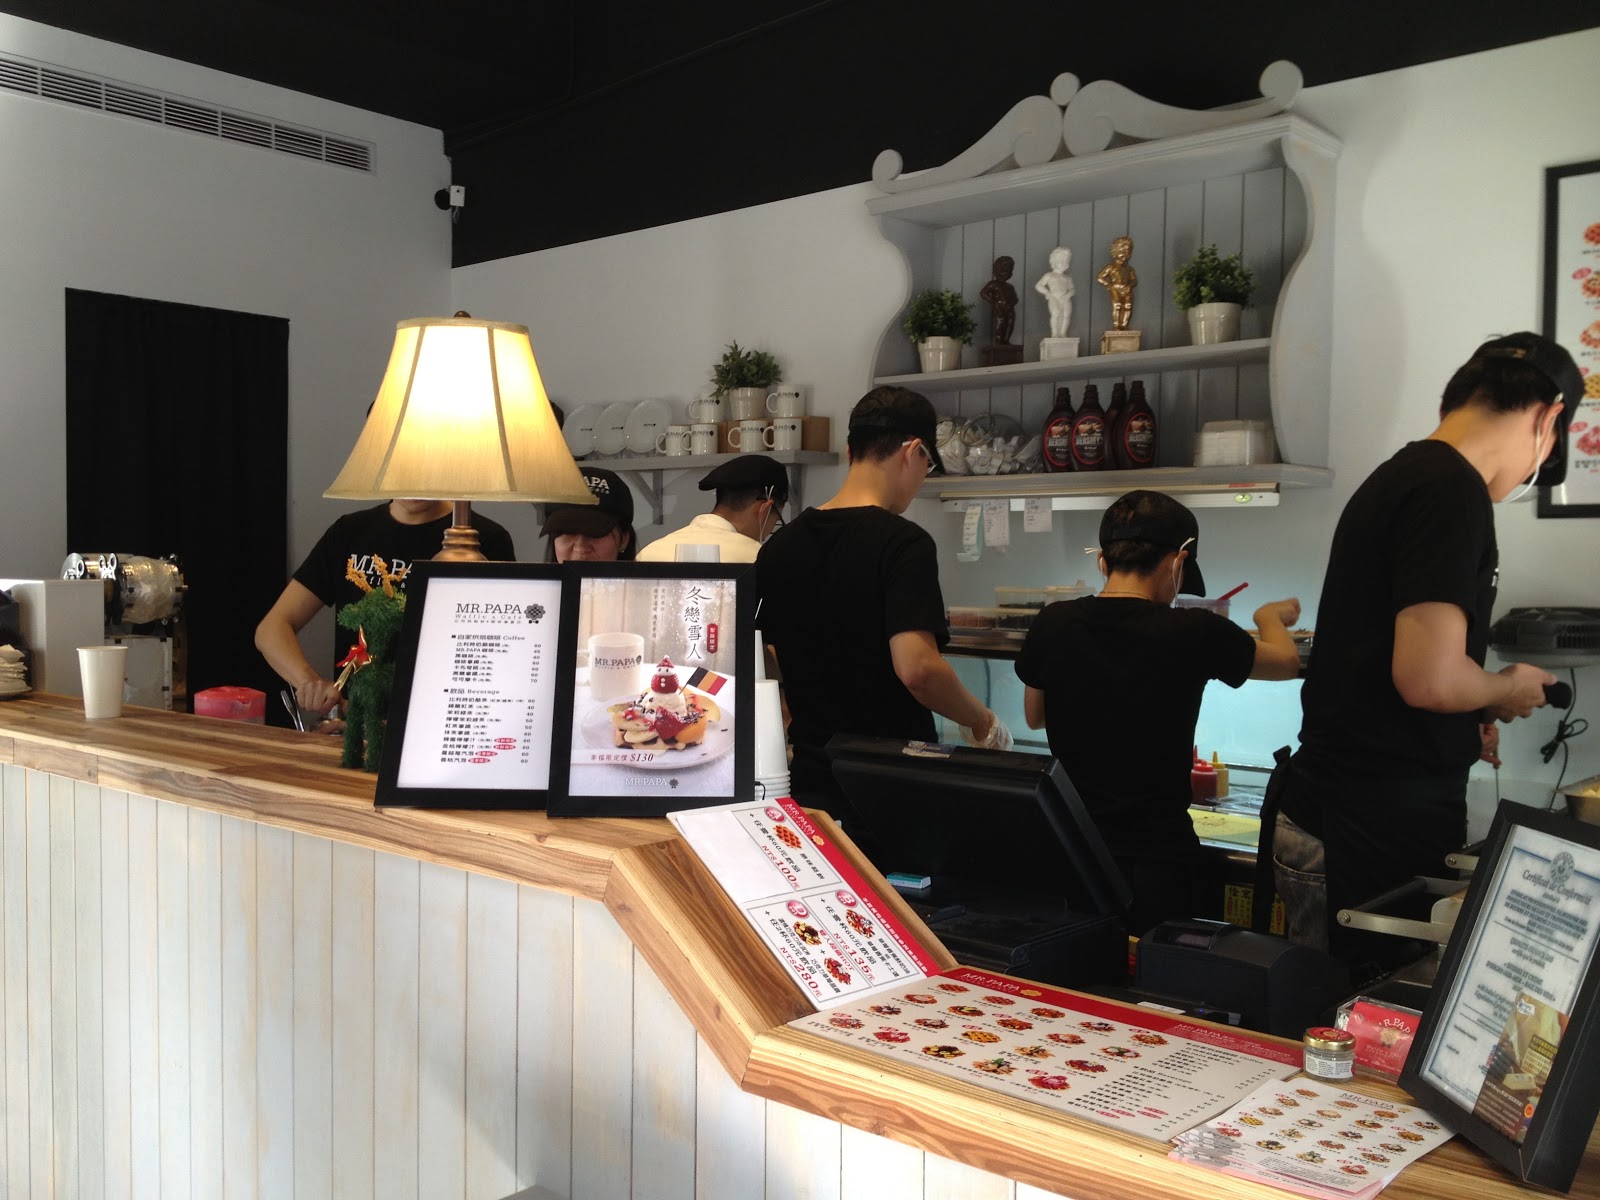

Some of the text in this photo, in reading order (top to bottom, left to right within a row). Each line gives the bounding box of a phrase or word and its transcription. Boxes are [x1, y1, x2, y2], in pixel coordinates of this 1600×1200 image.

[456, 603, 522, 614] MR.PAPA
[684, 586, 712, 660] 冬戀雪人
[595, 657, 635, 667] MR.PAPA
[629, 753, 654, 762] $130
[625, 777, 668, 786] MR.PAPA
[1522, 869, 1549, 887] Certificat
